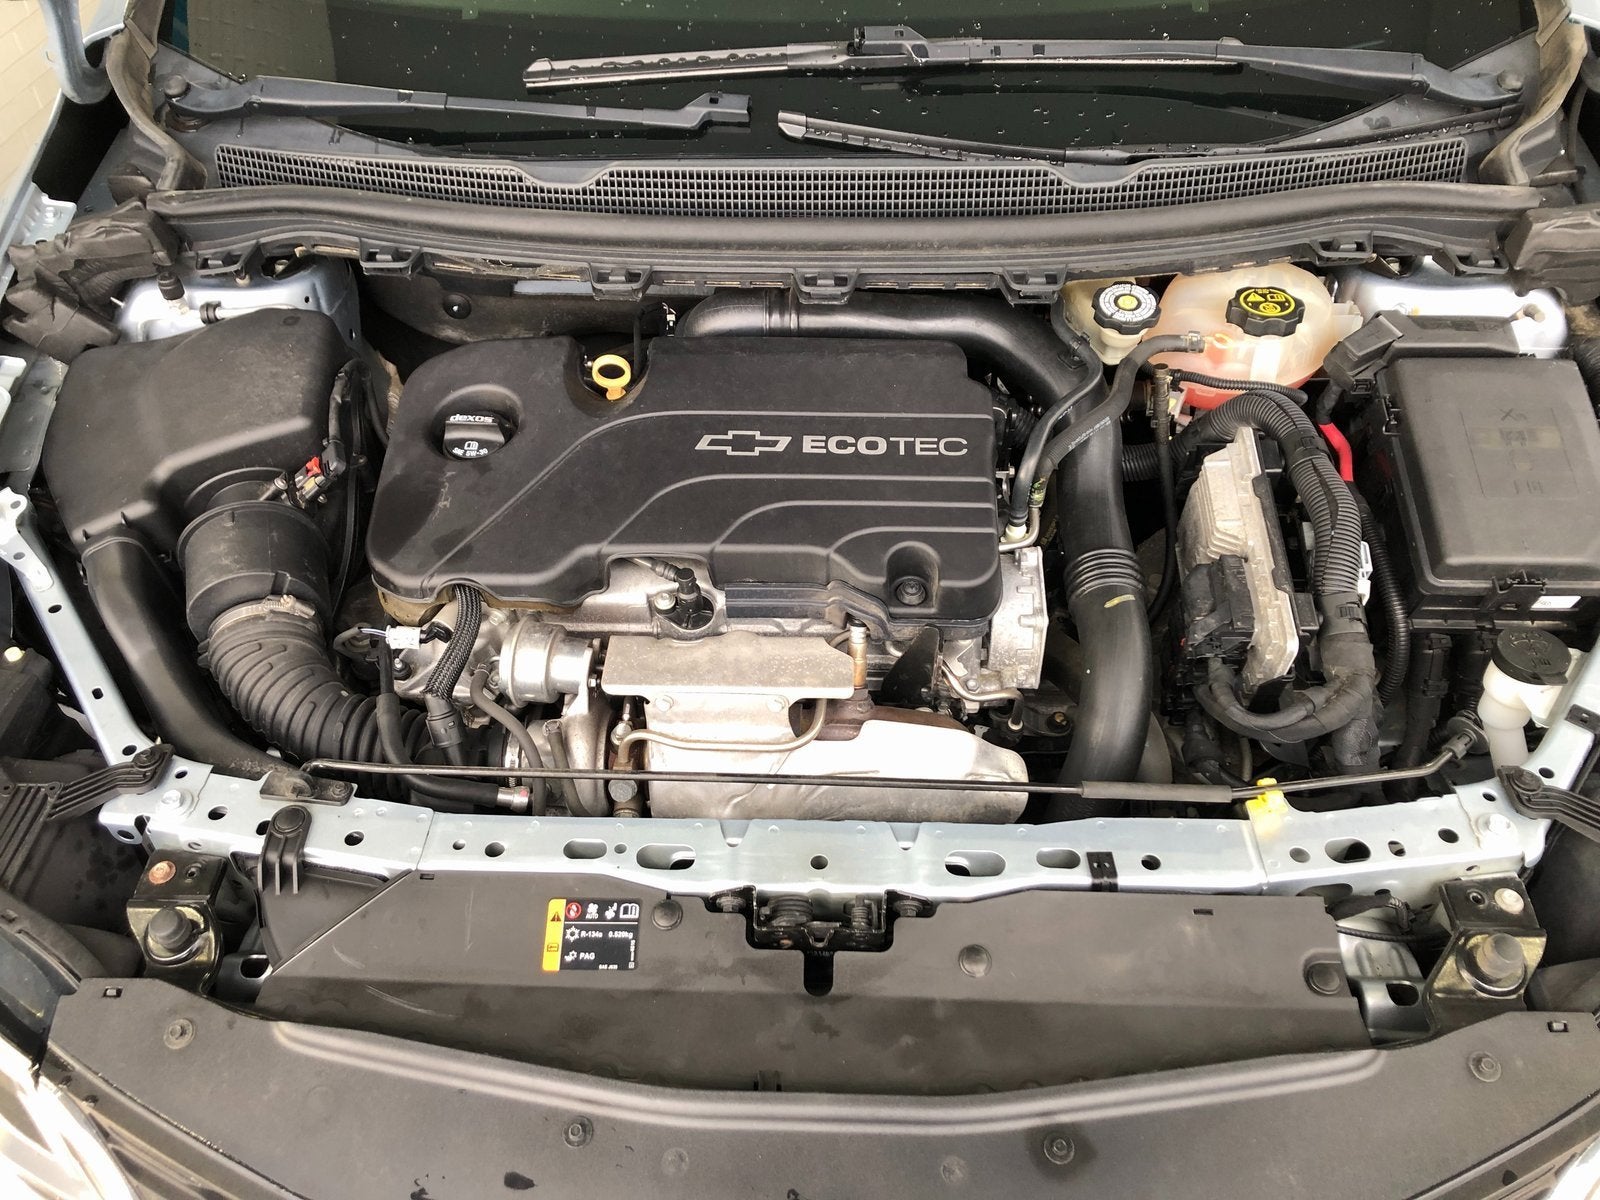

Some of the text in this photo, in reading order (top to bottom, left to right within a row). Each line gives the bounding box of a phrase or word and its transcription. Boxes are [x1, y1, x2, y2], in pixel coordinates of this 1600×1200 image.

[450, 414, 495, 423] dexos
[802, 435, 968, 456] ECOTEC
[452, 447, 488, 456] SAE 5W-30
[580, 952, 595, 960] PAG
